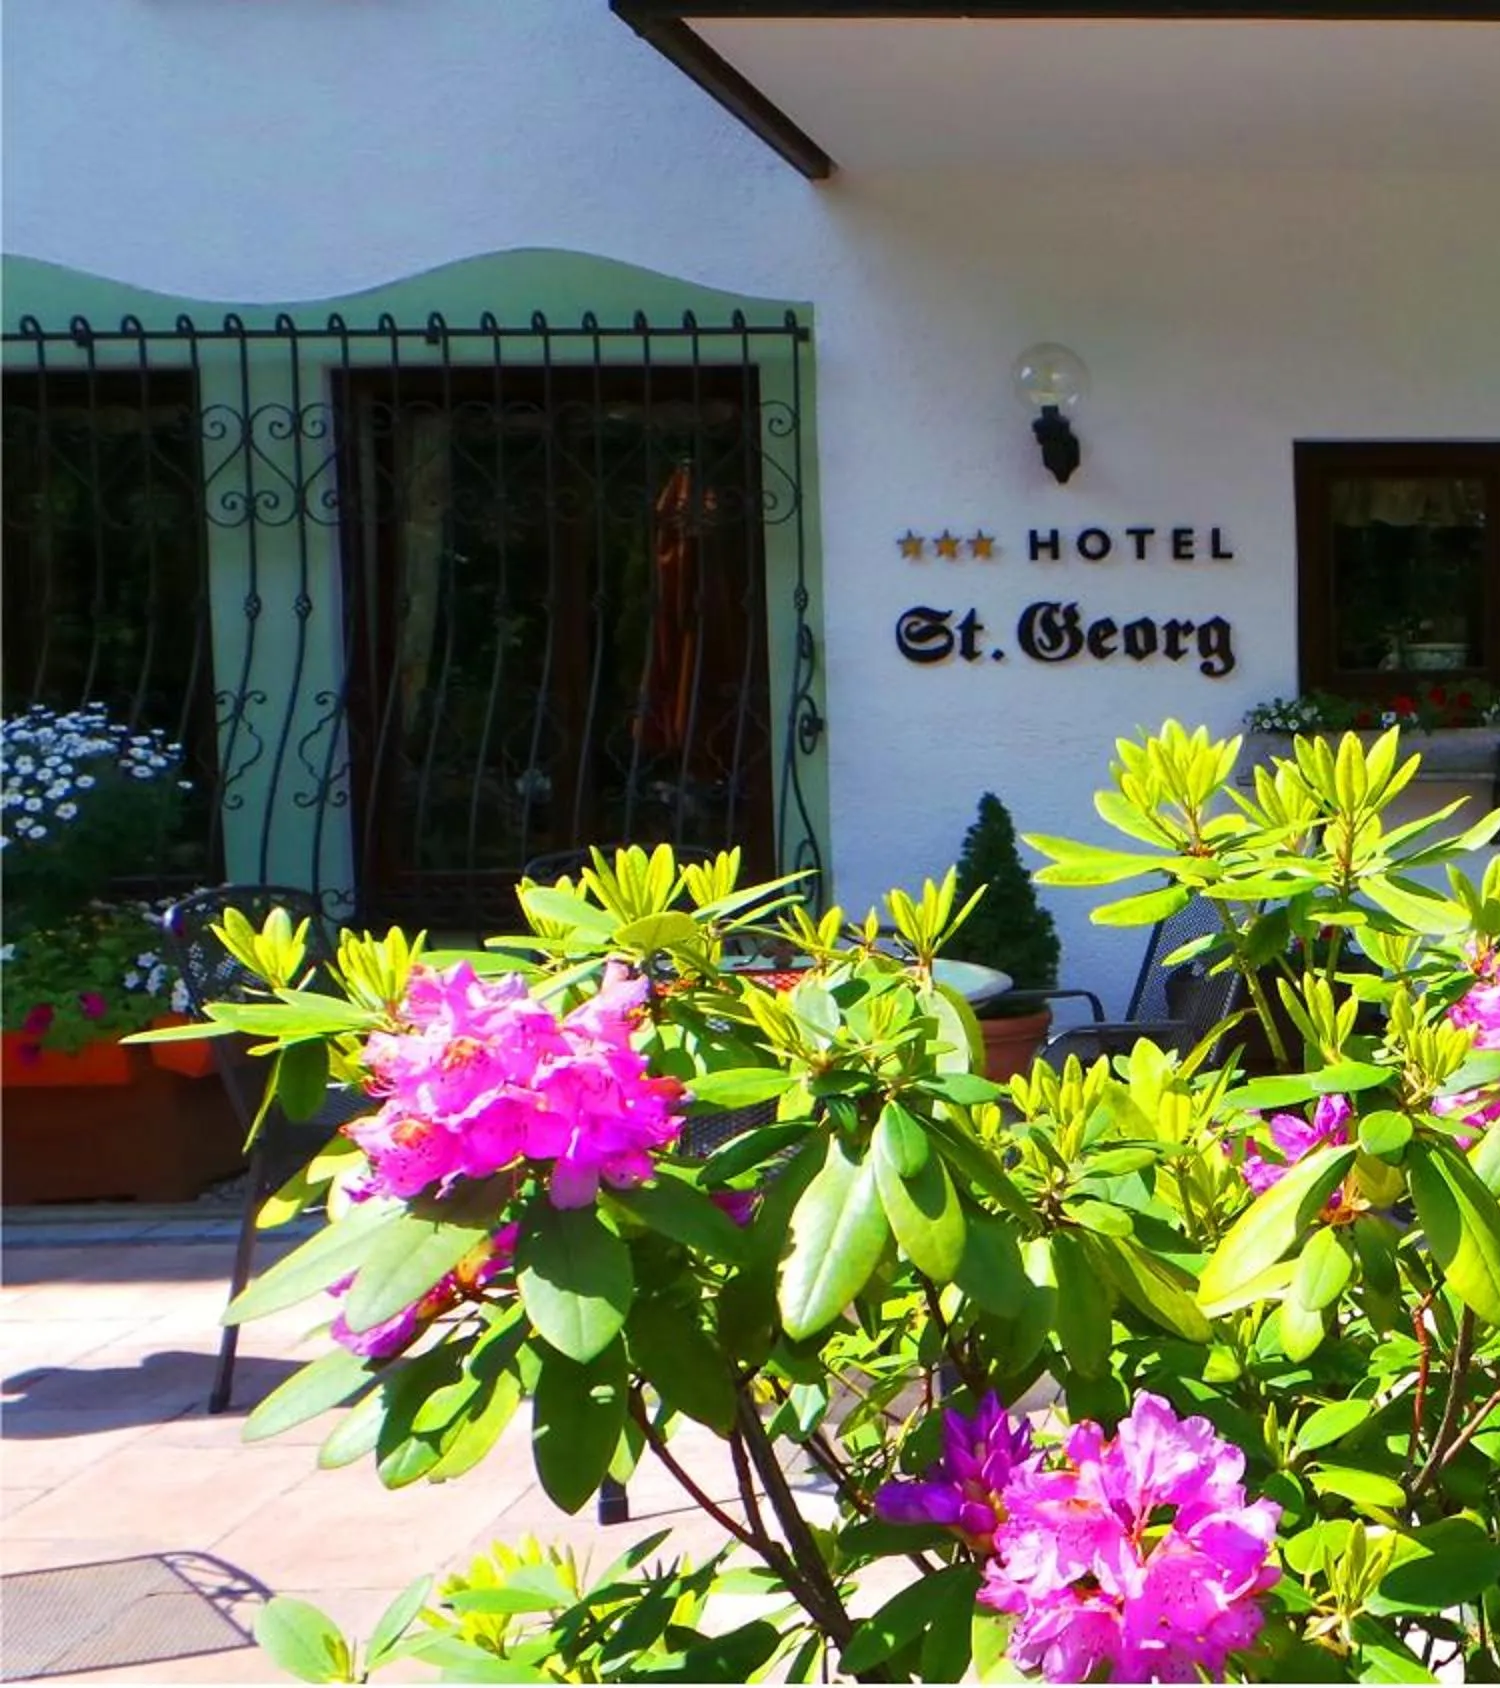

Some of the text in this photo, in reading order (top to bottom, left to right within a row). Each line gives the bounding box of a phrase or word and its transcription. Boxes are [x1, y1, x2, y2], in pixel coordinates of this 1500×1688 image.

[1028, 527, 1234, 561] HOTEL
[895, 601, 1236, 678] St. Georg
